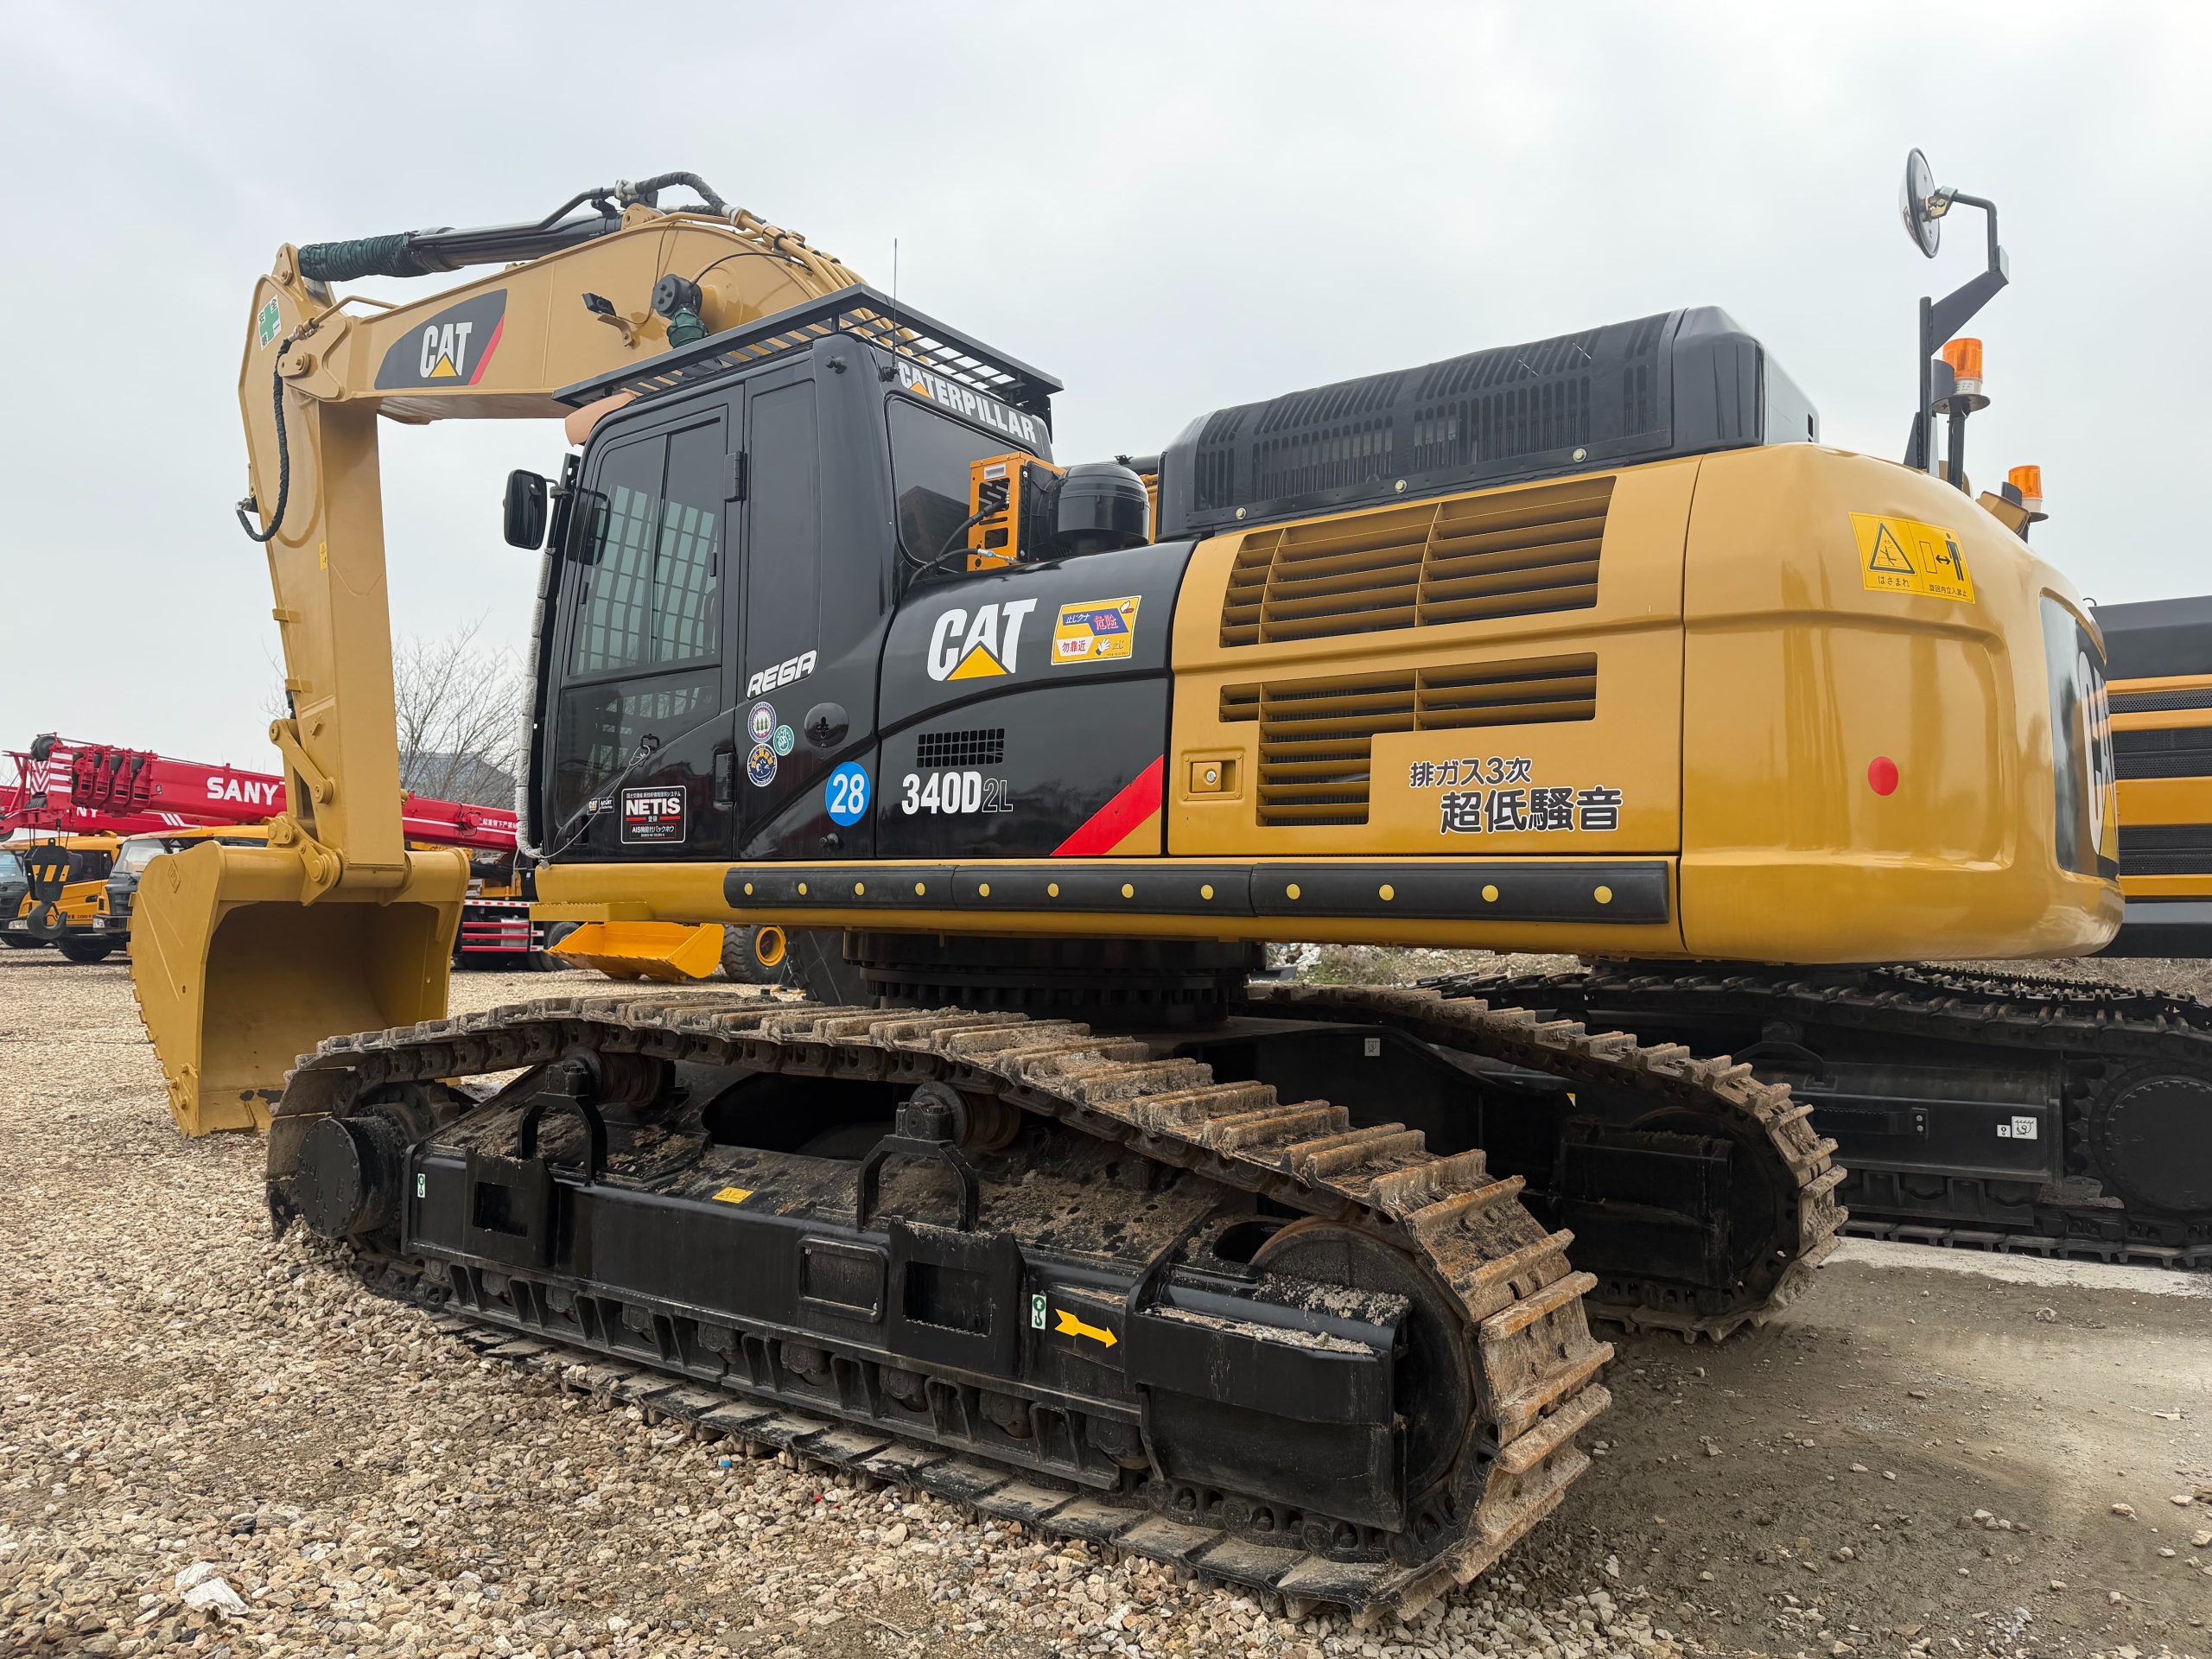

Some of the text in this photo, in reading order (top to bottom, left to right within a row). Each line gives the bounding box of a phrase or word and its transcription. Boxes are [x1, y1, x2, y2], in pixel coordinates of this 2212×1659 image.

[419, 321, 473, 378] CAT
[898, 361, 1037, 444] CATERPILLAR
[1878, 575, 1910, 588] はさまれ
[926, 597, 1039, 682] CAT
[1094, 614, 1118, 631] 危险
[1062, 639, 1086, 653] 勿靠近
[747, 650, 817, 698] REGA
[207, 776, 279, 805] SANY
[1409, 757, 1533, 788] 排ガス3次
[626, 798, 681, 816] NETIS
[830, 773, 865, 815] 28
[1440, 785, 1623, 835] 超低騒音
